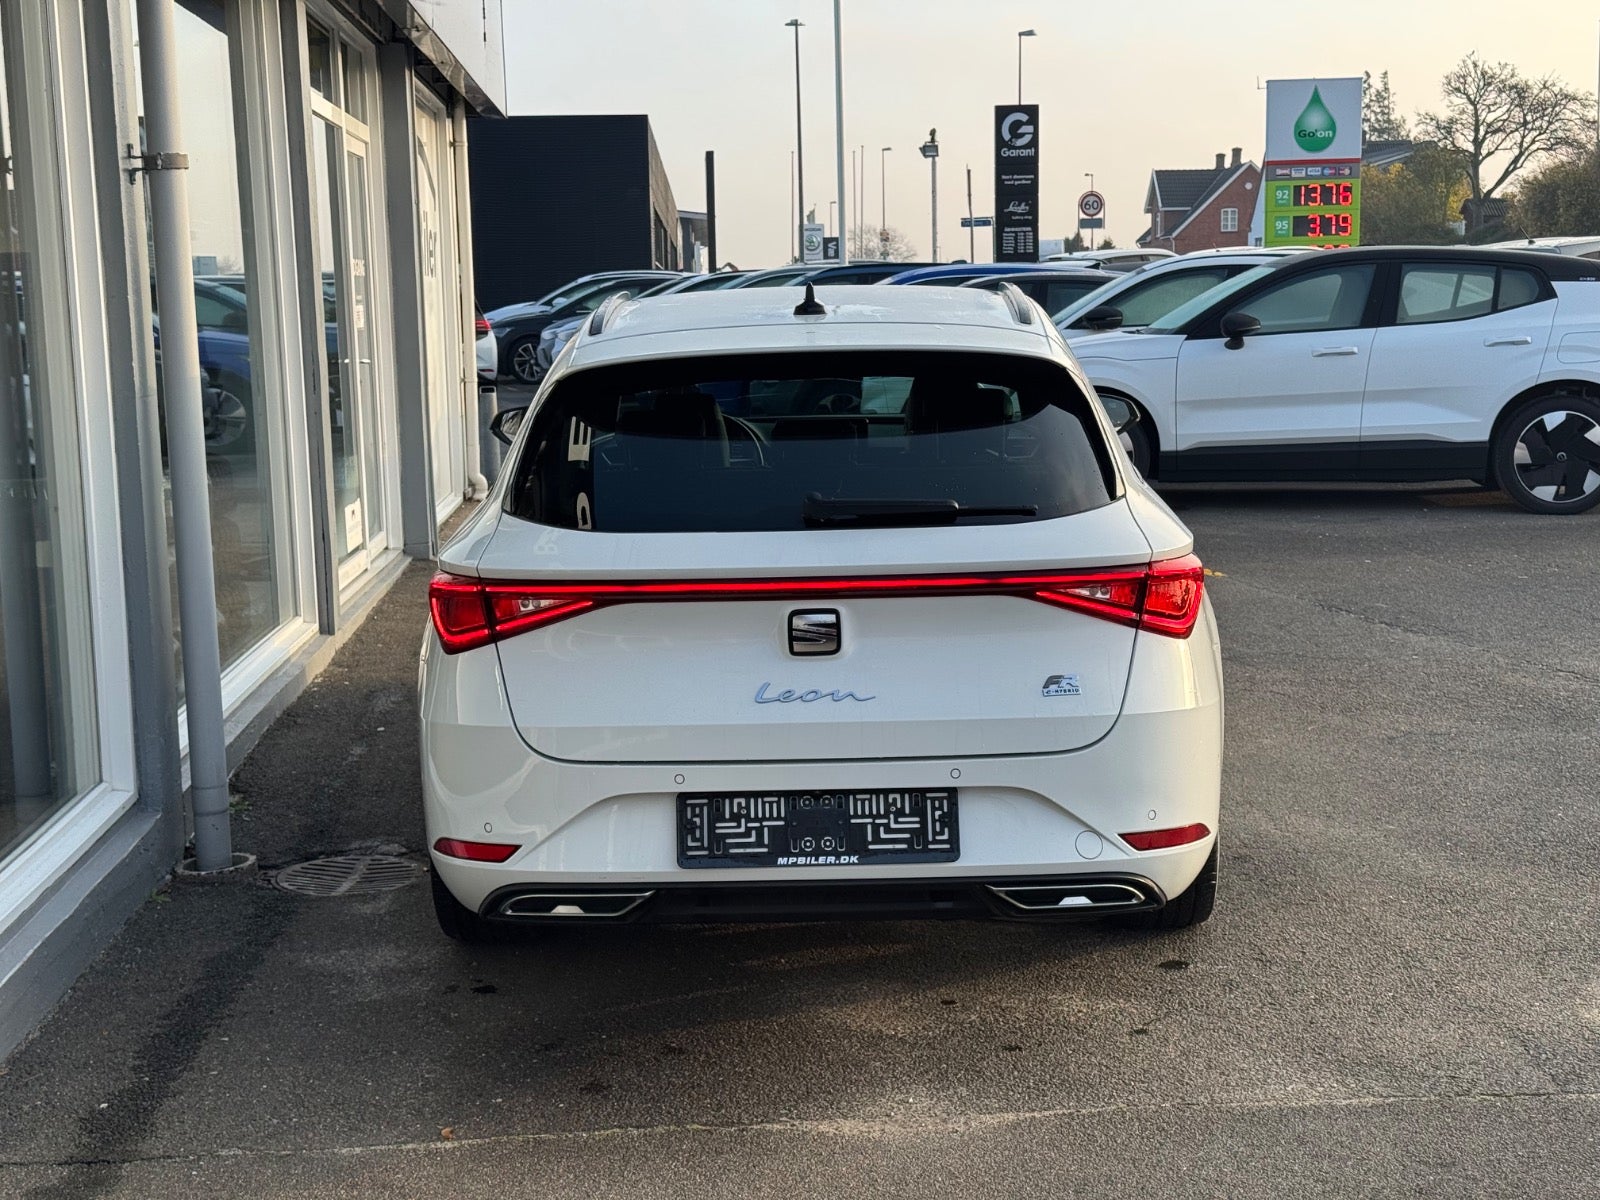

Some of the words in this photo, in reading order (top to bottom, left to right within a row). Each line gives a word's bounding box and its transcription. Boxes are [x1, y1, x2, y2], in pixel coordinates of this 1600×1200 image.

[1298, 129, 1333, 138] Go'on
[1001, 147, 1035, 157] Garant
[1275, 190, 1289, 199] 92
[1300, 183, 1353, 206] 13.76
[1084, 200, 1099, 210] 60
[1275, 221, 1289, 230] 95
[1307, 213, 1353, 237] 3.79
[423, 210, 437, 278] iler
[1043, 675, 1079, 688] FR
[755, 681, 876, 704] Leon
[777, 855, 859, 865] MPBILER.DK
